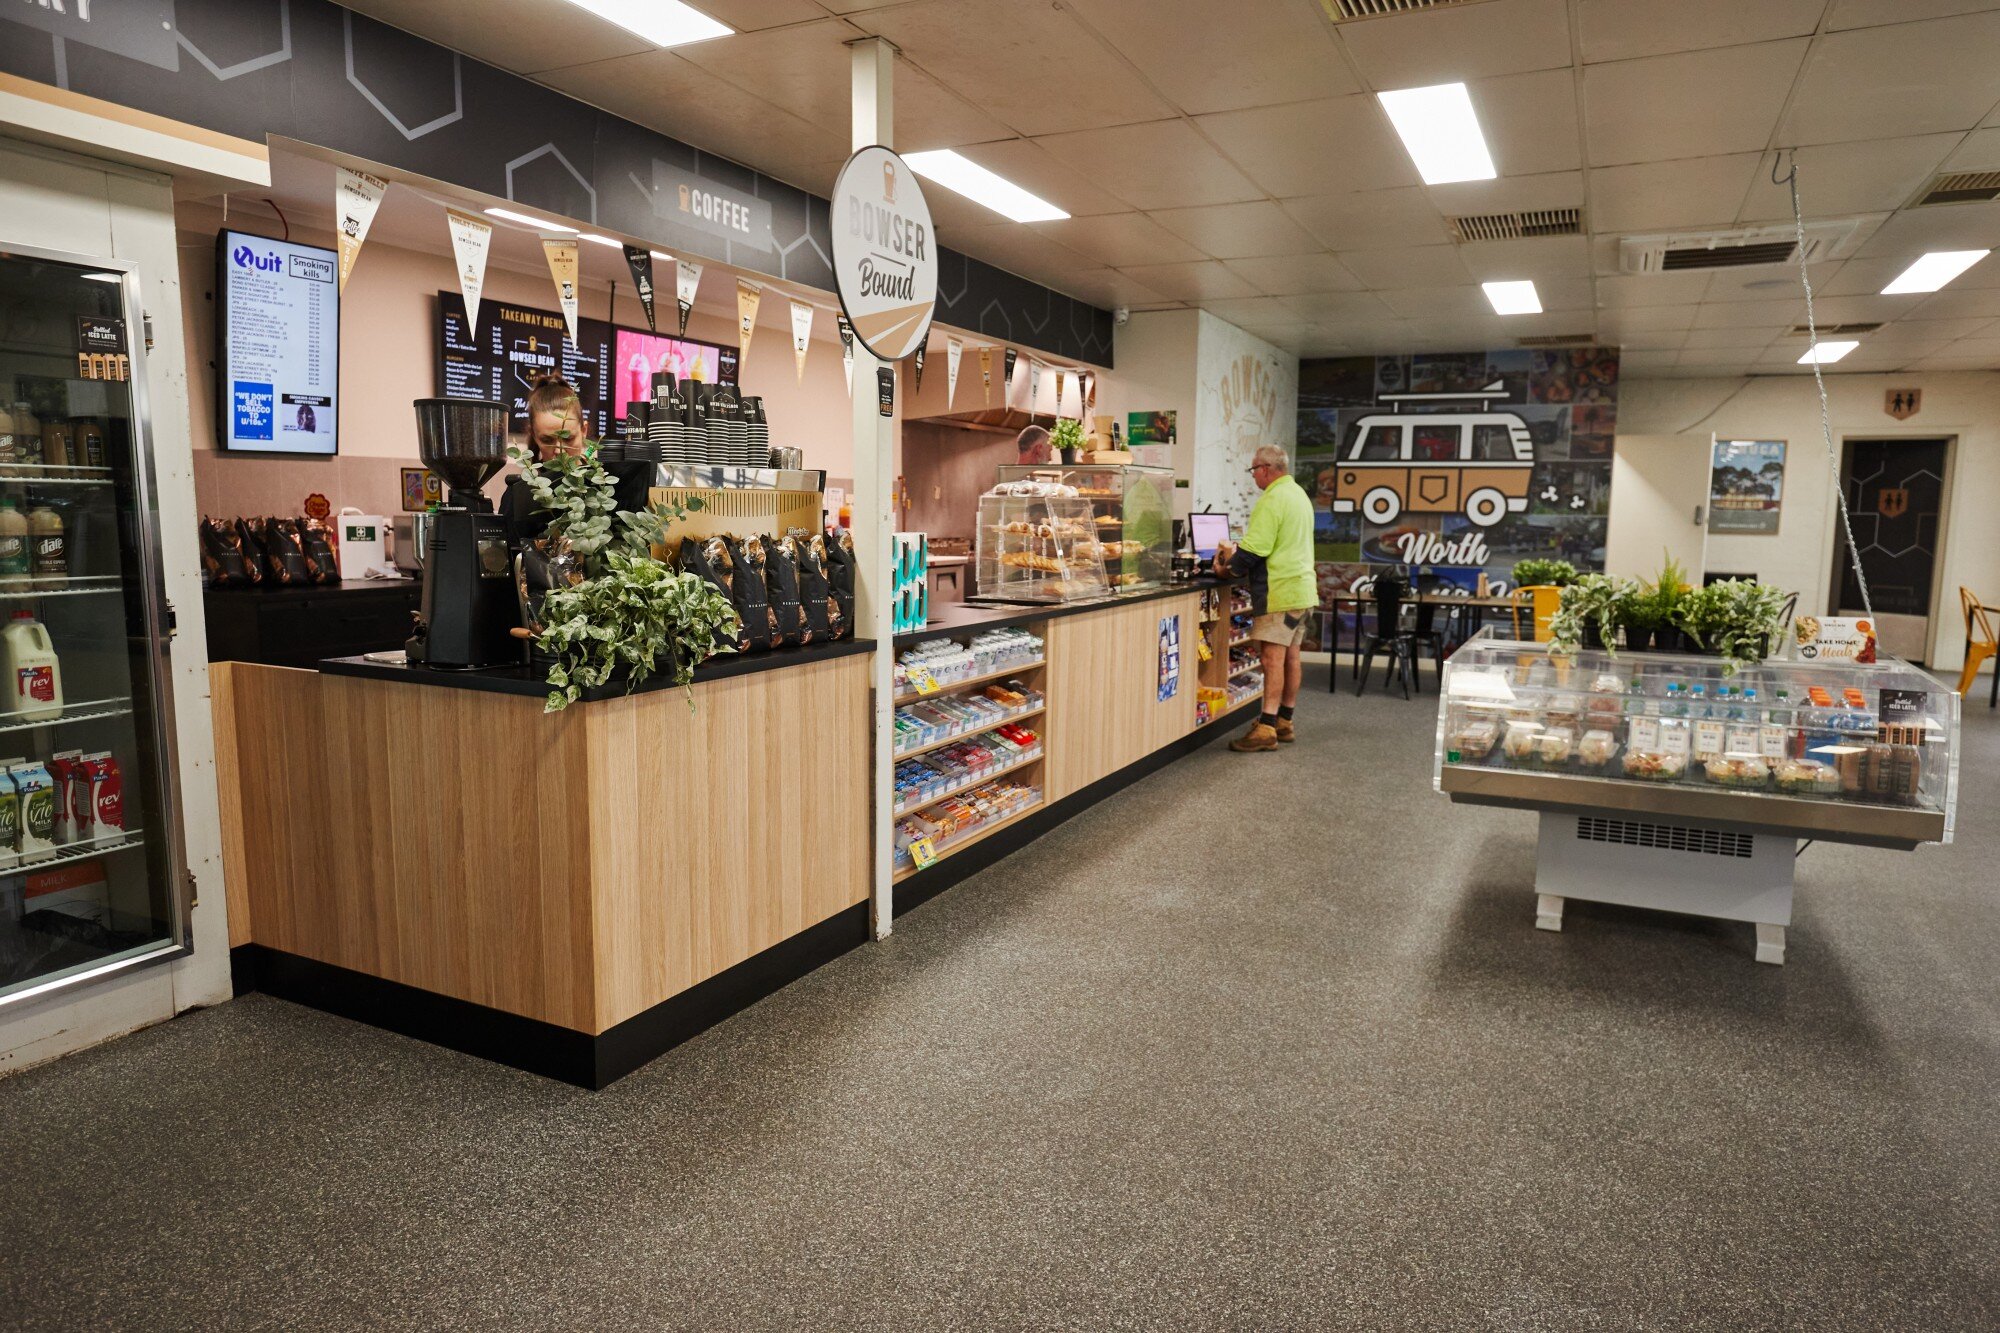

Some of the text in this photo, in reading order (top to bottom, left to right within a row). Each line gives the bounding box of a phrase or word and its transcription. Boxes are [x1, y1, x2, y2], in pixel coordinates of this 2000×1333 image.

[366, 175, 385, 190] HILLS
[344, 184, 371, 201] BOWSER BEAN
[691, 189, 750, 233] COFFEE
[849, 194, 926, 261] BOWSER
[234, 246, 282, 272] Quit
[294, 258, 329, 273] Smoking
[303, 269, 320, 279] kills
[858, 257, 916, 301] Bound
[500, 308, 563, 329] TAKEAWAY MENU
[88, 331, 100, 339] ICED
[510, 350, 555, 367] BOWSER BEAN
[237, 405, 270, 413] TOBACCO
[880, 403, 892, 413] FREE
[40, 537, 63, 555] dare
[1397, 532, 1490, 565] Worth
[1820, 644, 1853, 657] Meals
[32, 676, 50, 687] rev
[99, 790, 121, 807] rev
[41, 871, 67, 887] MILK
